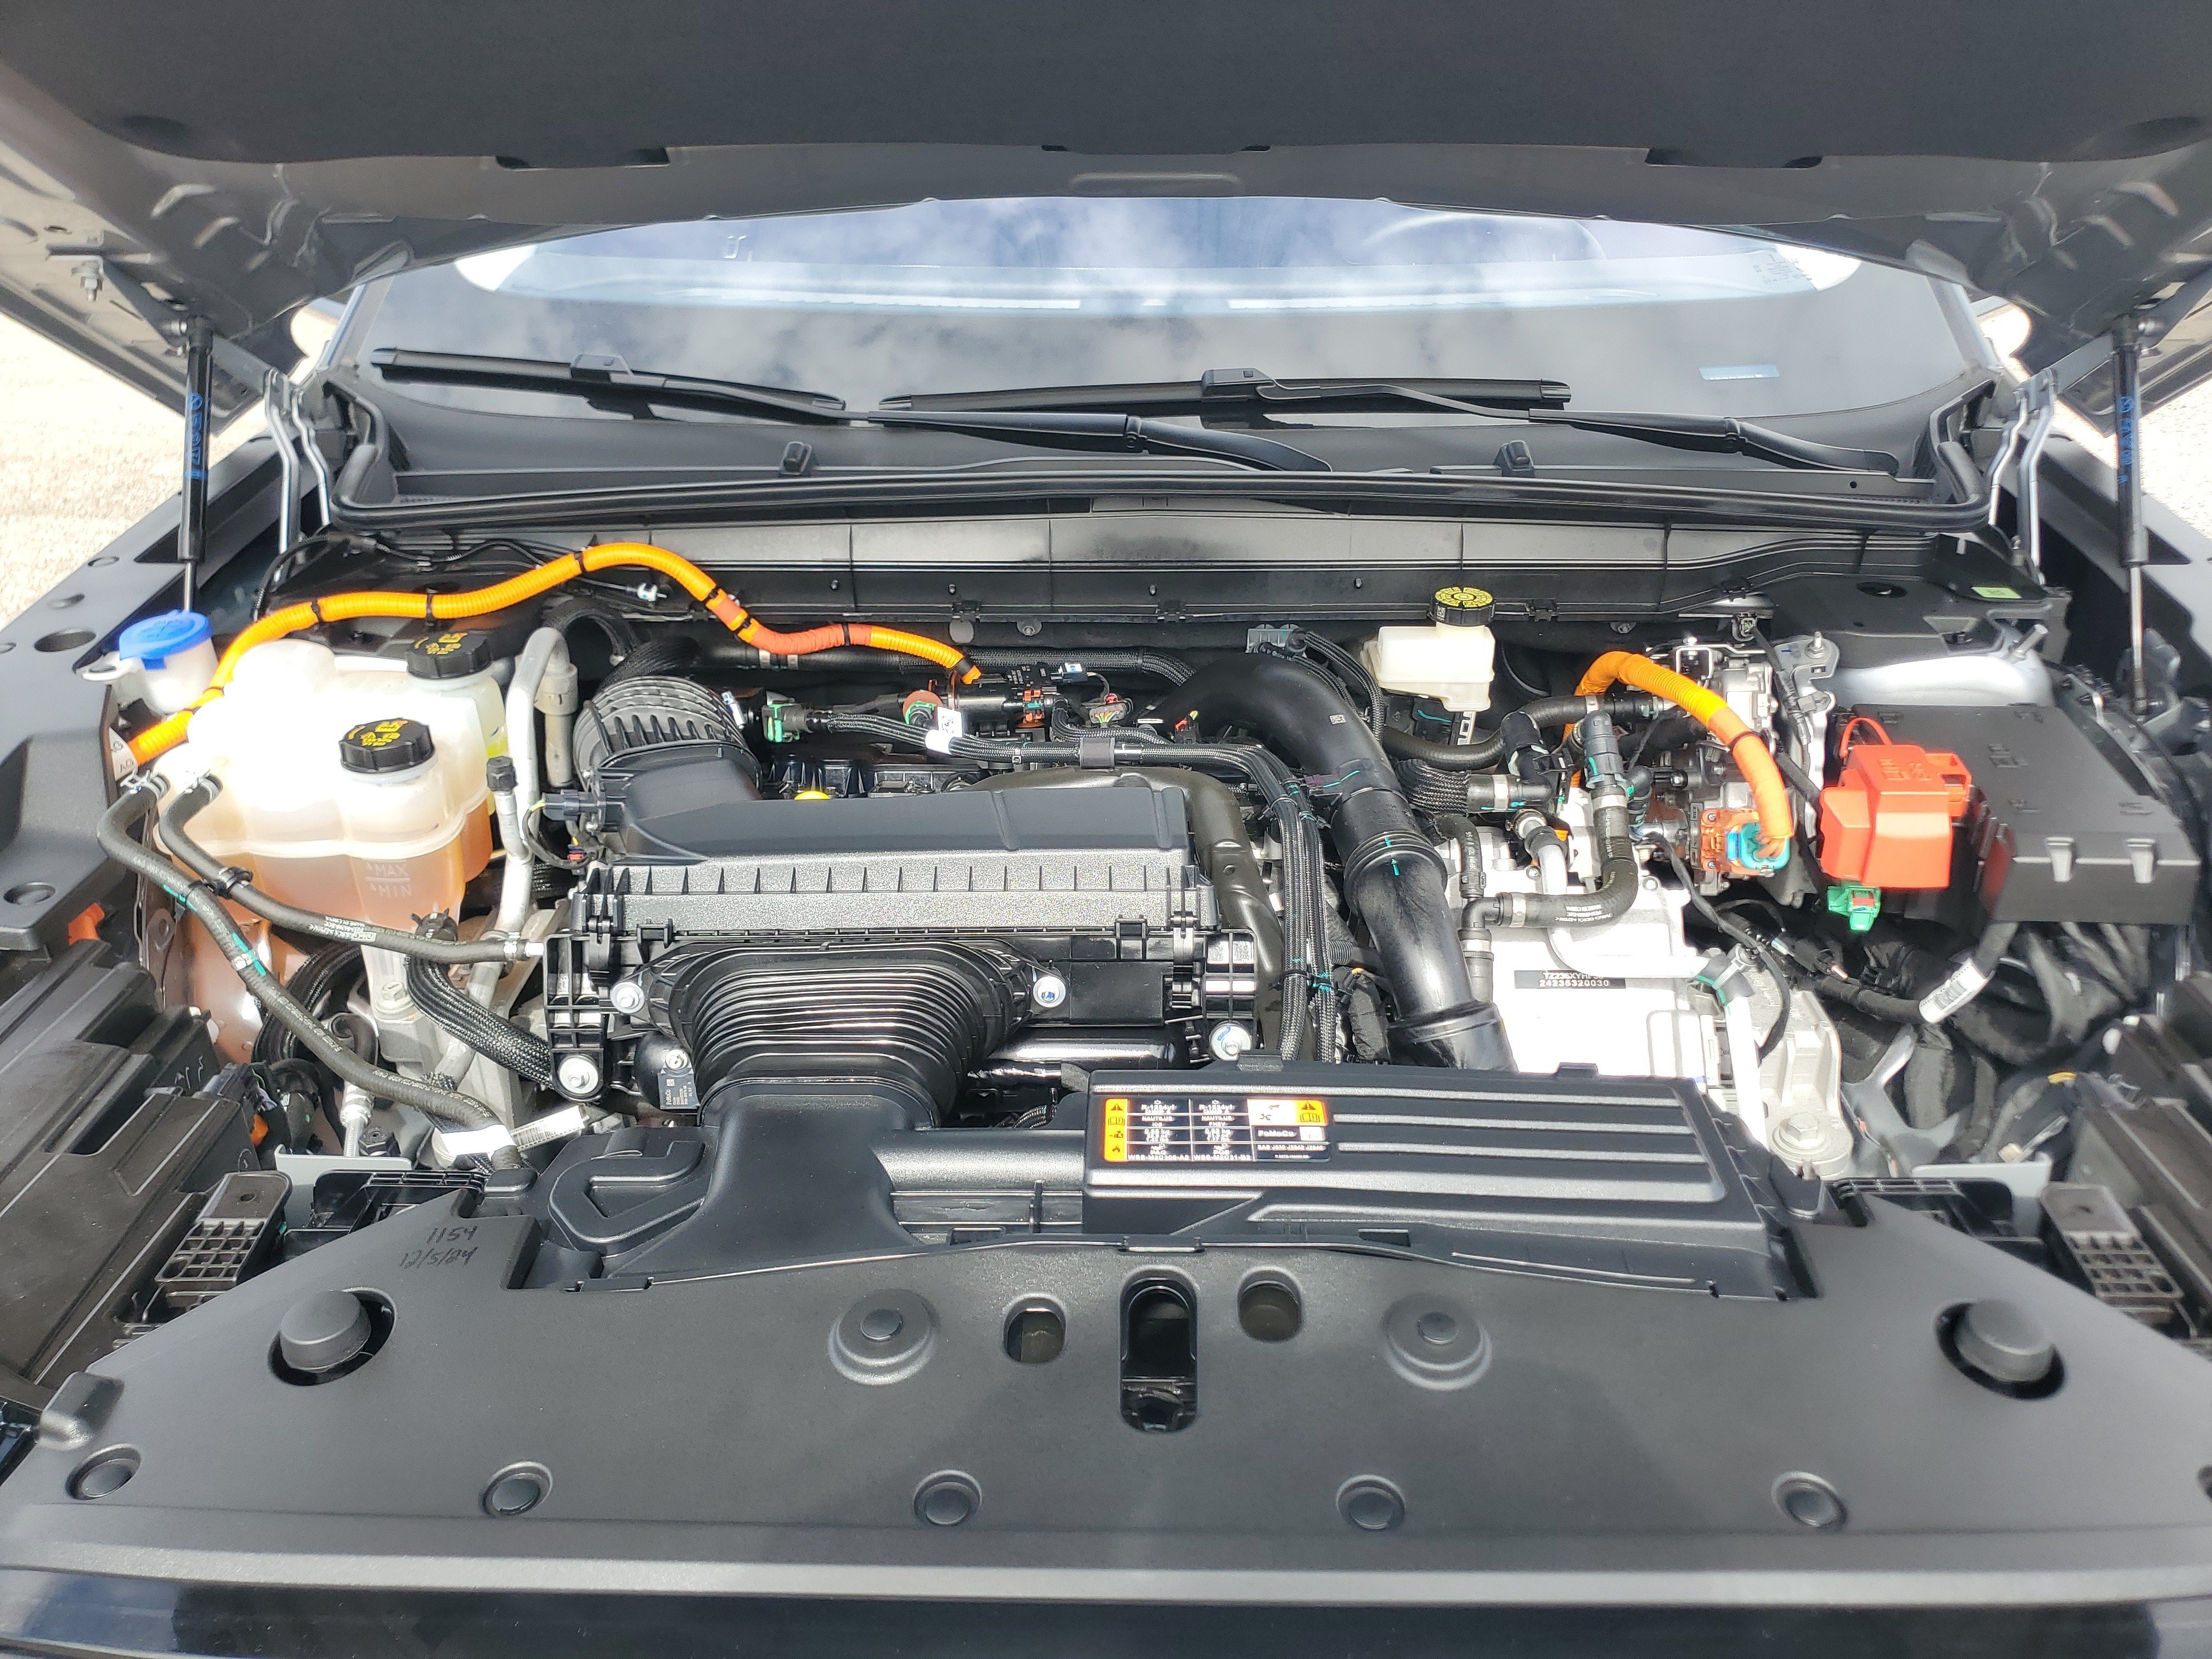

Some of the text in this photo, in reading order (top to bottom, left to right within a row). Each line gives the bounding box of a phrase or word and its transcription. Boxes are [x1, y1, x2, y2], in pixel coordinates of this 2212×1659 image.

[374, 864, 409, 877] MAX
[379, 884, 413, 898] MIN
[425, 1225, 477, 1244] 1154
[399, 1246, 478, 1269] 12/5/24
